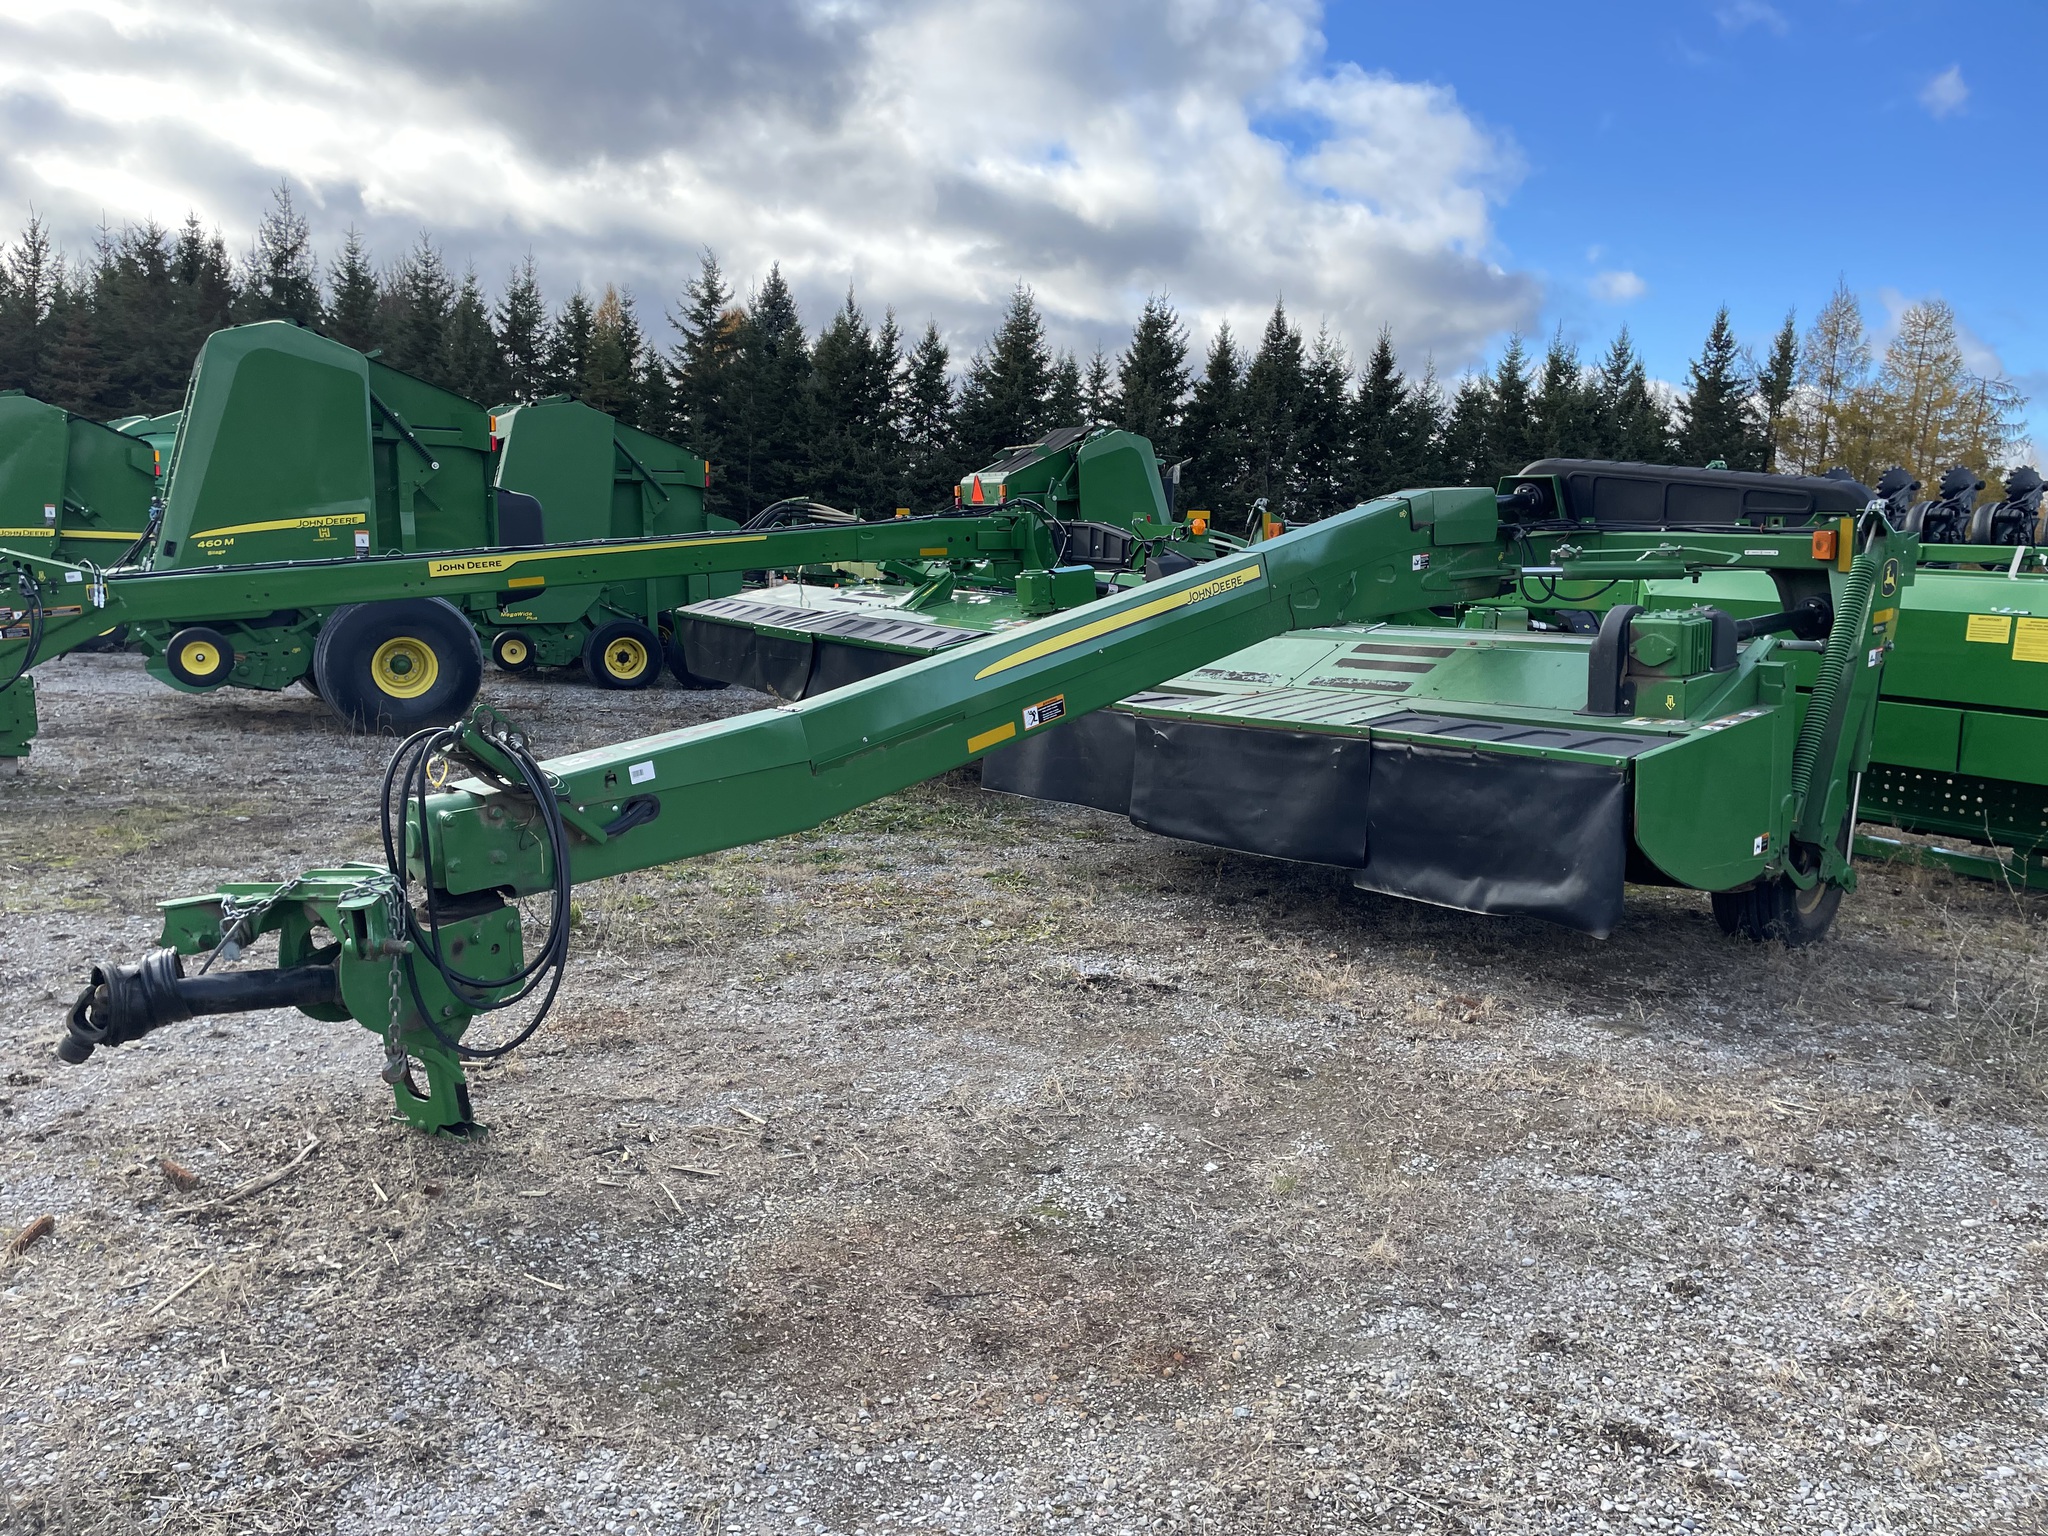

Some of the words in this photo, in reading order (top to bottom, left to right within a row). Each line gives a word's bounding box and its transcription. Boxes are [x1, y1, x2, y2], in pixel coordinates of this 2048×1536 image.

[297, 519, 324, 528] JOHN
[326, 517, 358, 525] DEERE
[197, 540, 223, 548] 460
[224, 538, 234, 546] M
[437, 563, 465, 572] JOHN
[467, 560, 503, 570] DEERE
[1187, 587, 1212, 604] JOHN
[1212, 576, 1243, 594] DEERE
